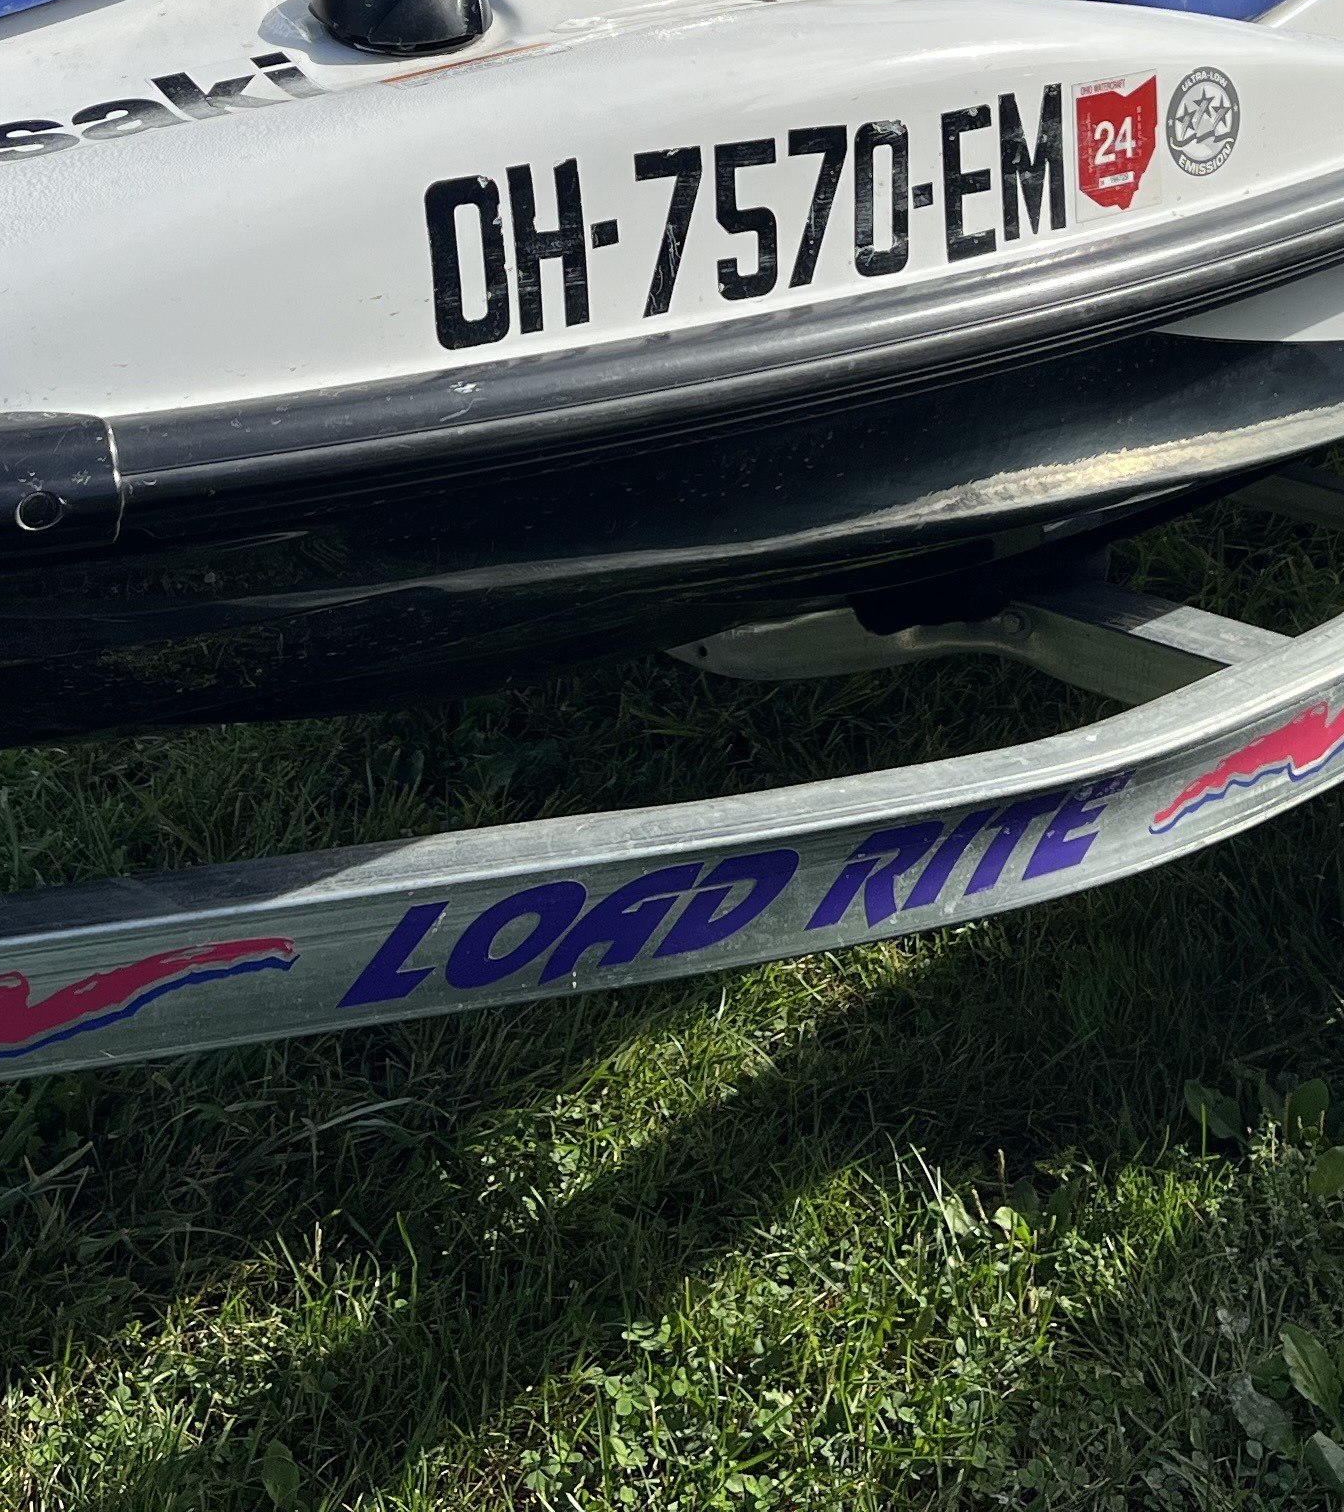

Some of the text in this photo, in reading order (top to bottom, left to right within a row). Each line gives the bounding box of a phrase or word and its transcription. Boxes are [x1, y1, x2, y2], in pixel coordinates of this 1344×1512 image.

[1181, 70, 1228, 92] ULTRA-LOW
[1093, 116, 1136, 165] 24
[1178, 143, 1232, 175] EMISSION
[424, 82, 1067, 350] OH-7570-EM
[336, 767, 1138, 1009] LOAD RITE
